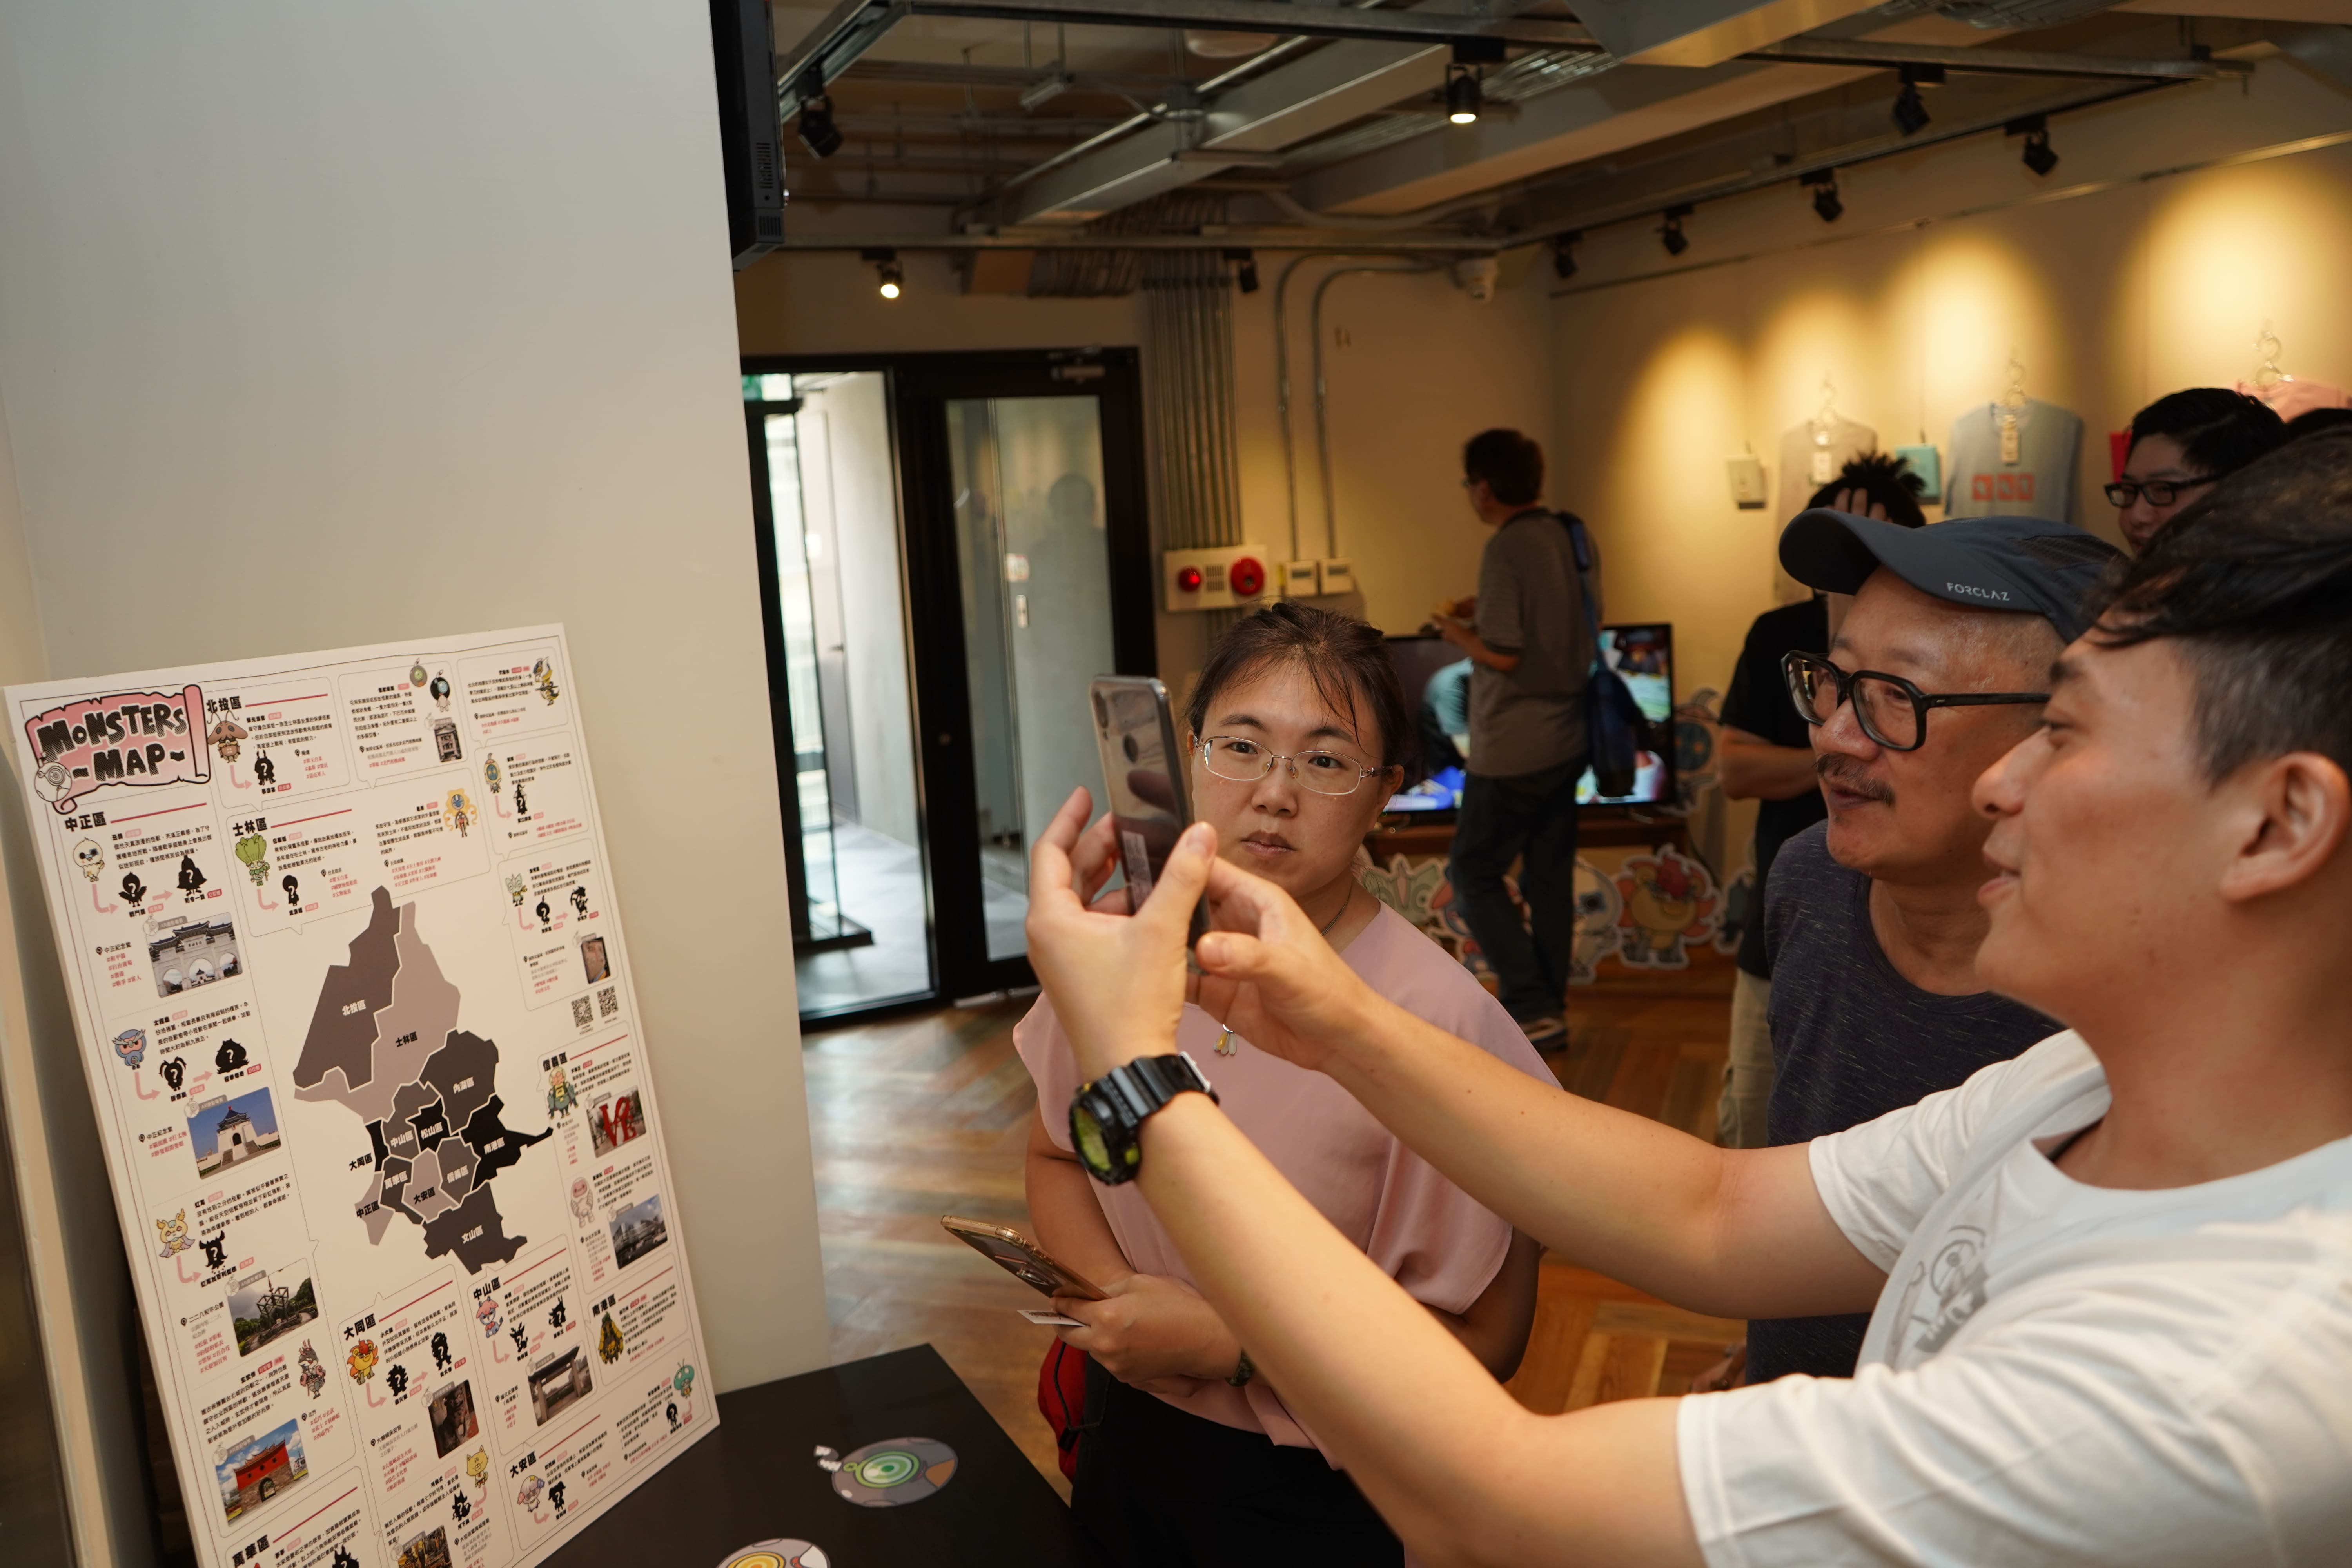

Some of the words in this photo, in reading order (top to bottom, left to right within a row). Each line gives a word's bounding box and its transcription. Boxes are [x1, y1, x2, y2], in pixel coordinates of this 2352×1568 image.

[1946, 582, 2011, 602] FORCLAZ
[205, 696, 242, 713] 北投區
[94, 743, 166, 782] MAP
[64, 811, 107, 833] 中正區
[232, 817, 268, 837] 士林區
[104, 941, 131, 954] 中正紀念堂
[341, 999, 366, 1016] 北投區
[395, 1031, 418, 1048] 士林區
[542, 1051, 567, 1072] 信義區
[452, 1077, 474, 1094] 內湖區
[147, 1125, 173, 1140] 中正紀念堂
[390, 1130, 413, 1149] 中山區
[420, 1122, 443, 1140] 松山區
[484, 1137, 505, 1154] 南港區
[348, 1153, 373, 1171] 大同區
[384, 1170, 408, 1189] 萬華區
[446, 1165, 468, 1184] 信義區
[413, 1187, 435, 1205] 大安區
[356, 1200, 380, 1219] 中正區
[461, 1225, 483, 1244] 文山區
[473, 1276, 501, 1302] 中山區
[188, 1301, 224, 1323] 二二八和平公園
[592, 1293, 616, 1317] 南港區
[343, 1313, 376, 1341] 大同區
[509, 1450, 536, 1479] 大安區
[232, 1534, 270, 1568] 萬華區
